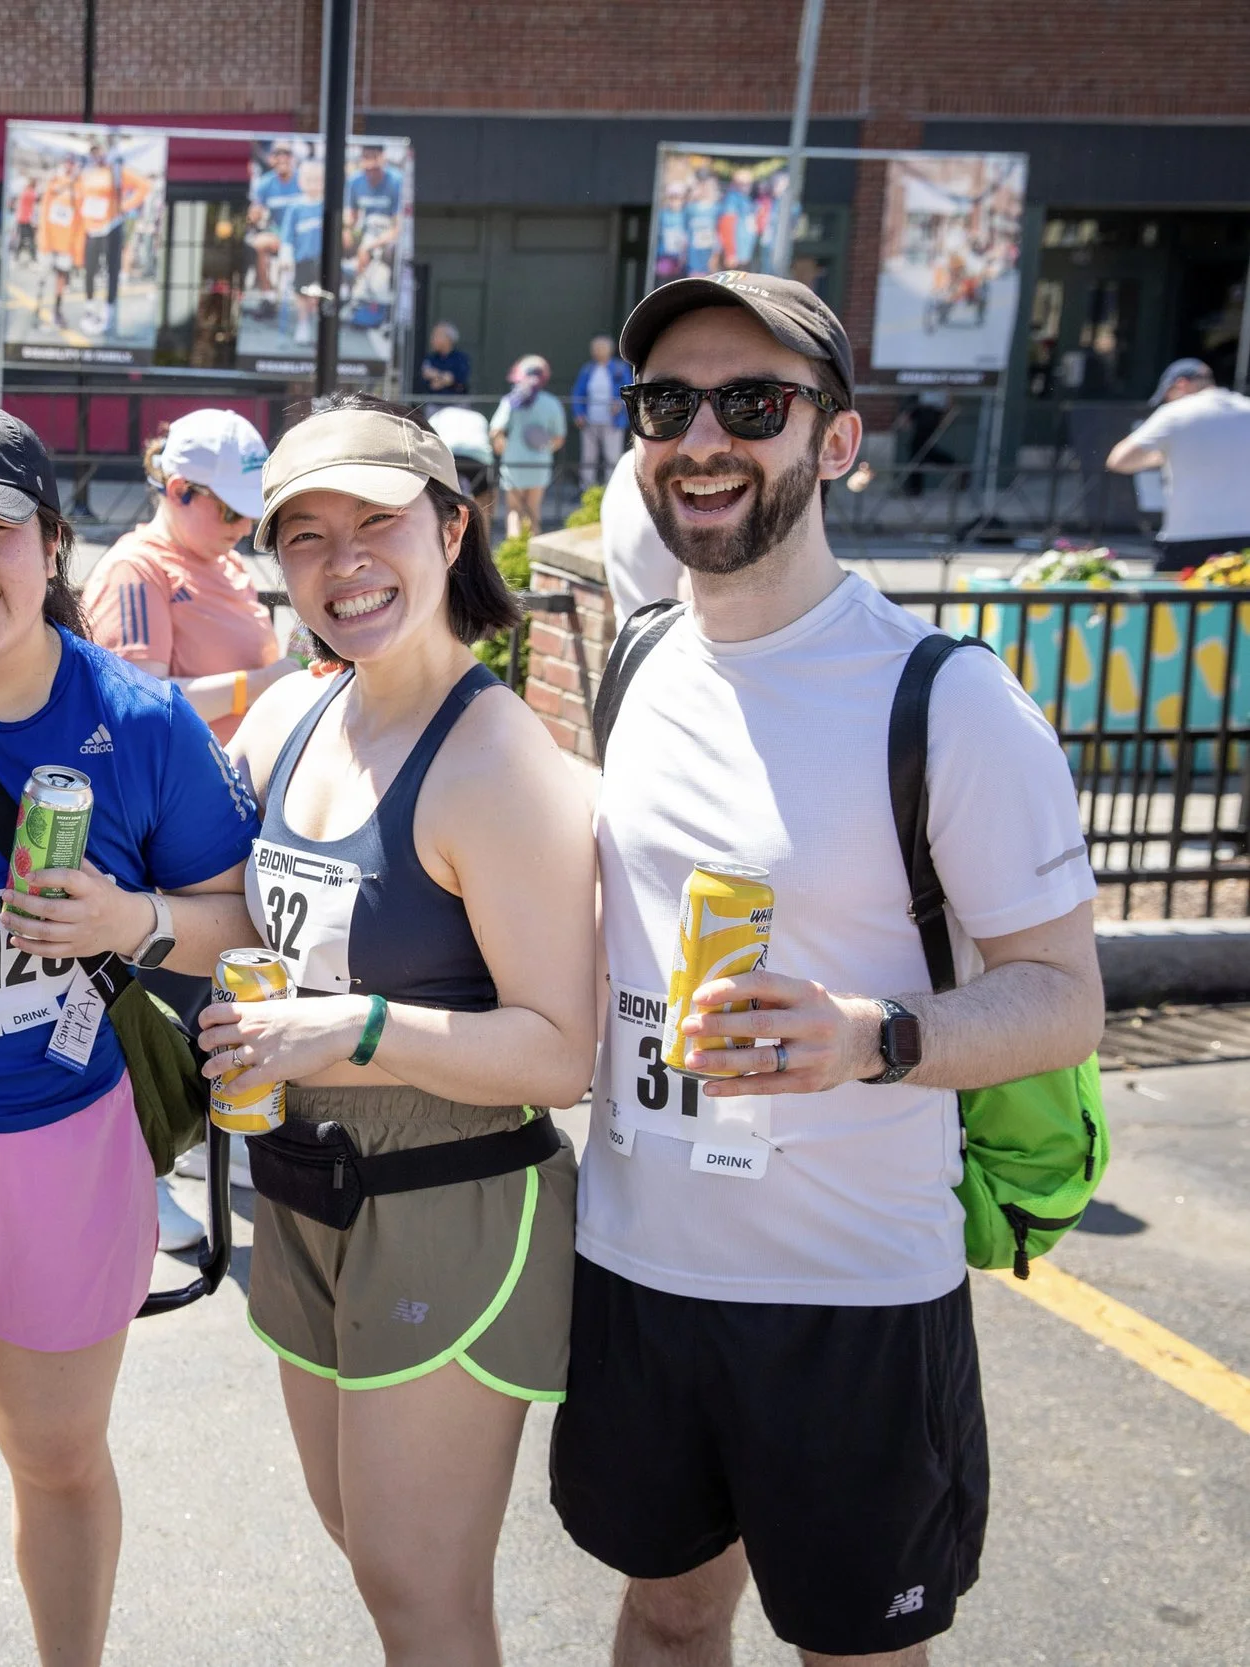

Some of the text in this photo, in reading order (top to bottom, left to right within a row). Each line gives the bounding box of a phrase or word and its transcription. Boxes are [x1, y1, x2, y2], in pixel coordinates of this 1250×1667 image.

[258, 848, 326, 883] BIONIC
[325, 864, 344, 875] 5K&
[266, 886, 308, 961] 32
[214, 988, 237, 1003] POOL
[618, 991, 668, 1024] BIONI
[13, 1008, 51, 1026] DRINK
[706, 1153, 752, 1169] DRINK
